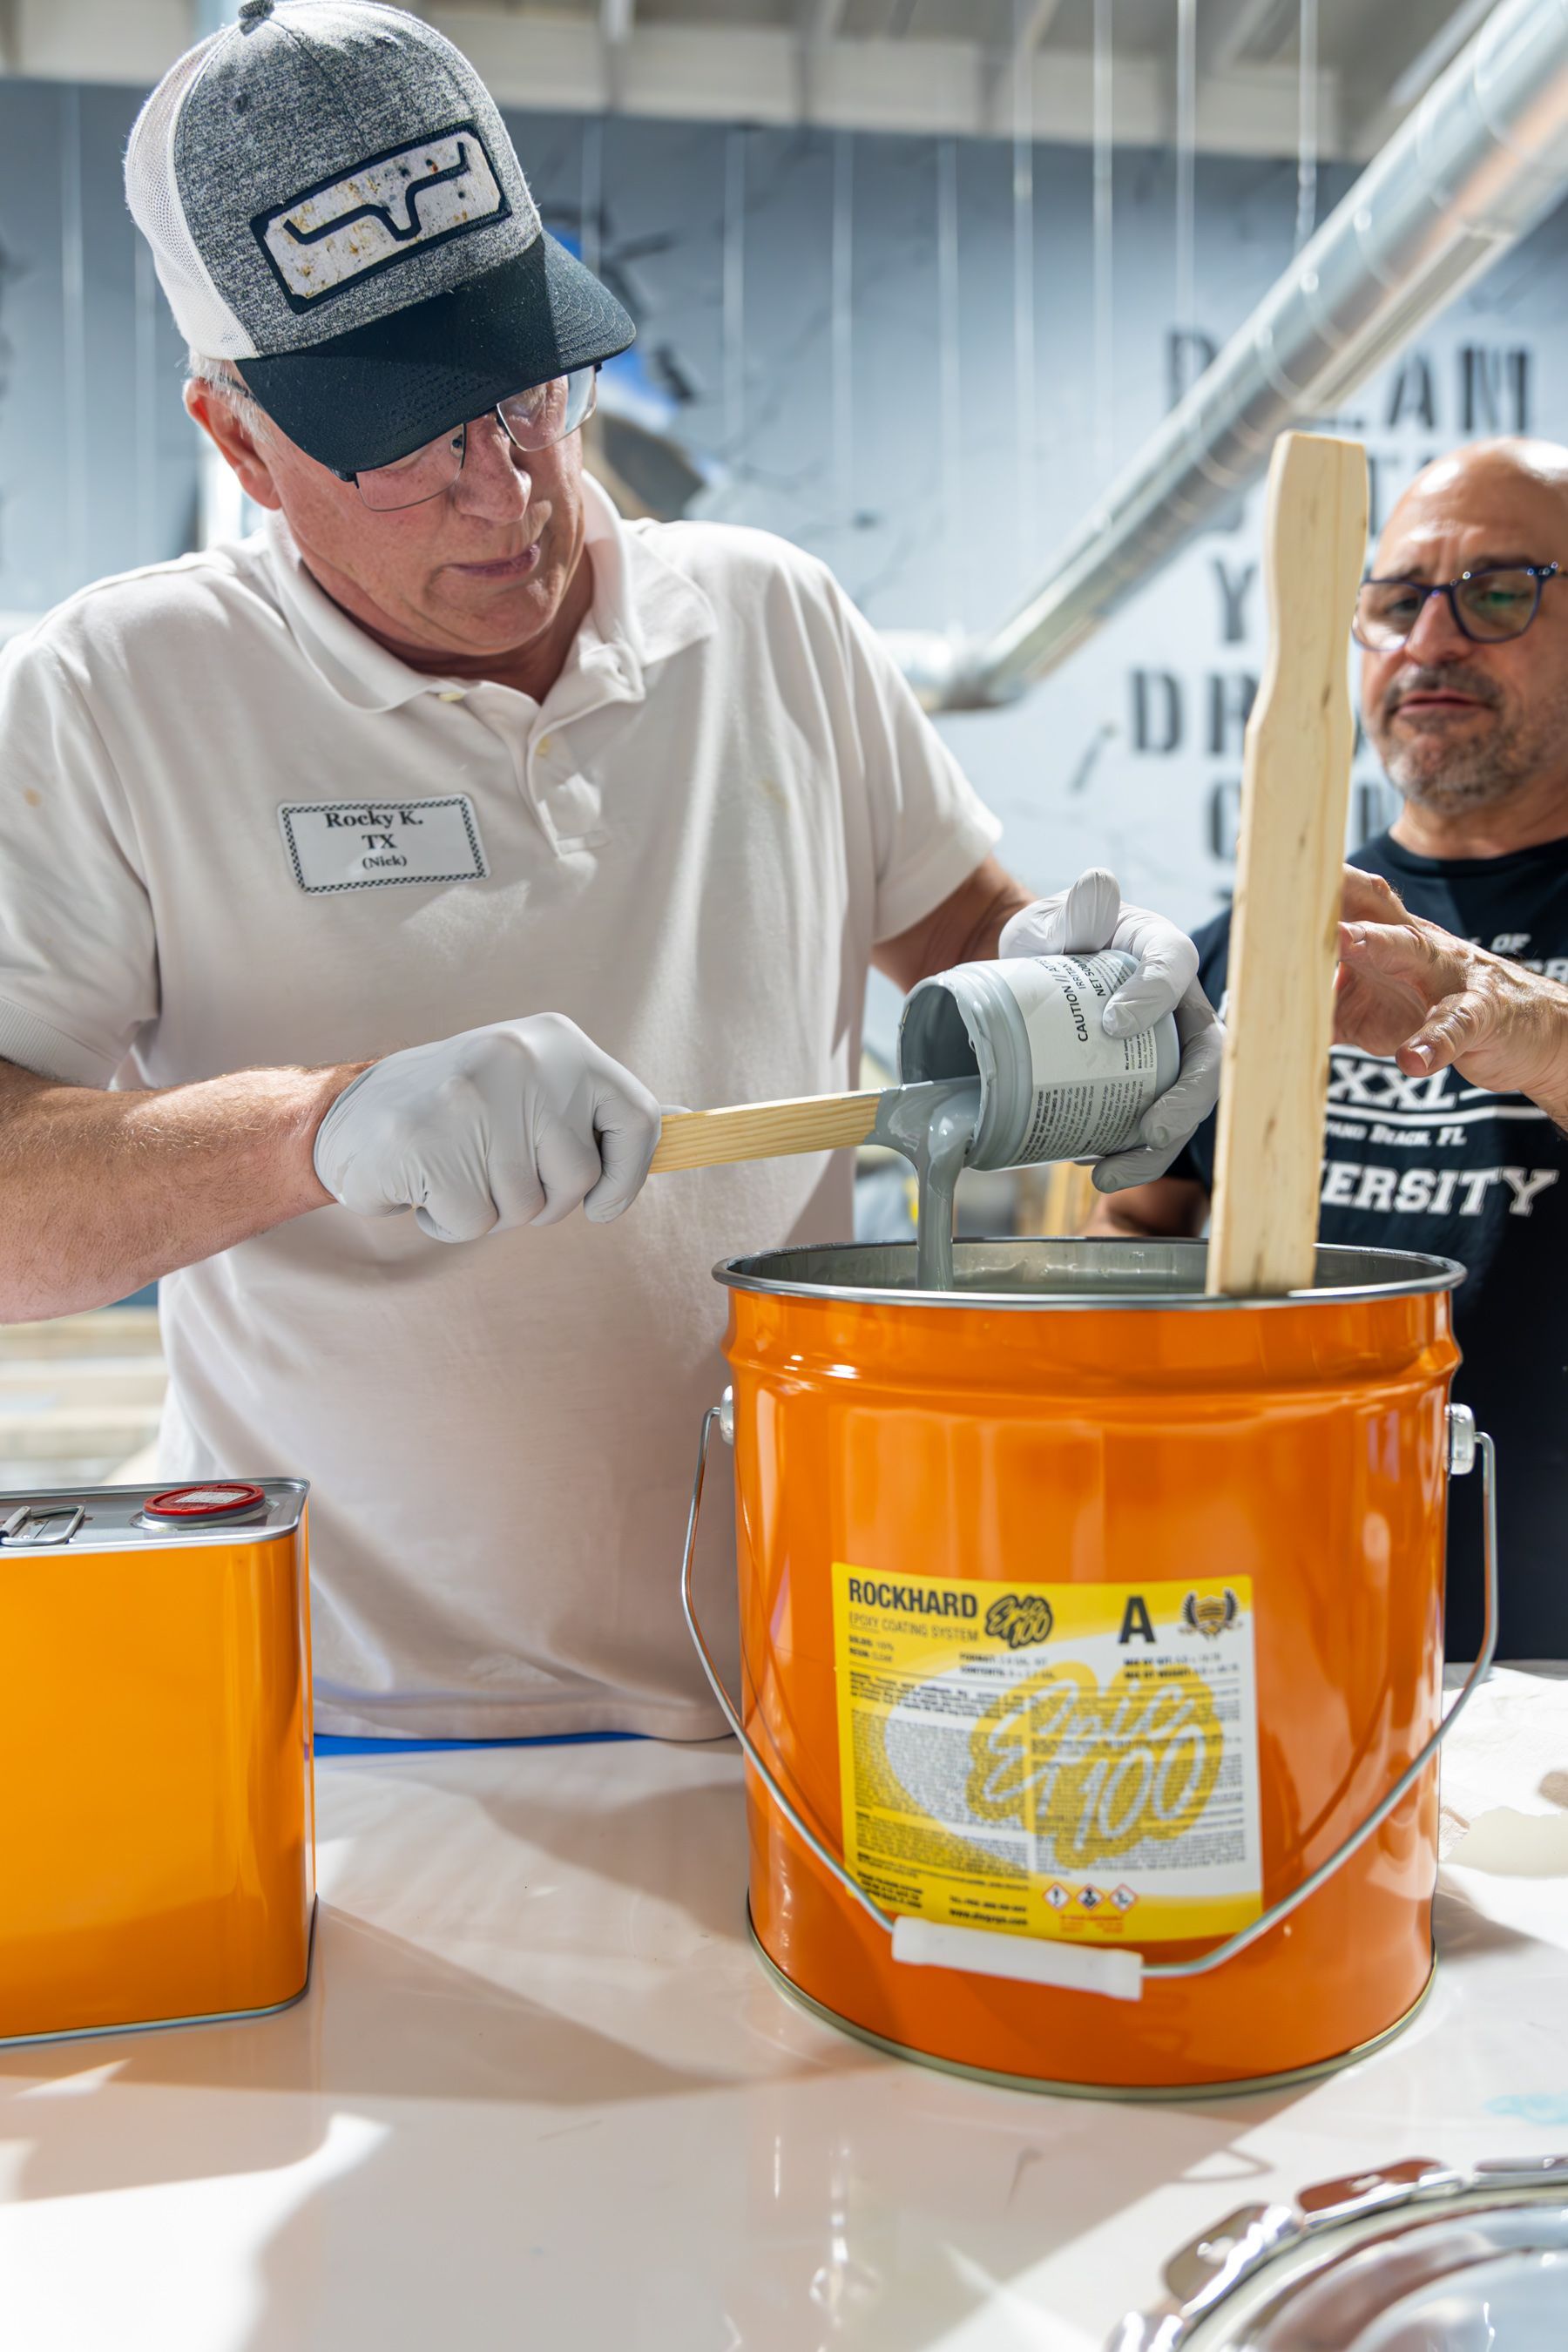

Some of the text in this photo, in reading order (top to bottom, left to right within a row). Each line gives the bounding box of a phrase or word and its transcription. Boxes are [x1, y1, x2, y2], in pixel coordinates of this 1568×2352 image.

[1167, 329, 1531, 433] DAM
[324, 810, 424, 829] Rocky K.
[362, 833, 398, 850] TX
[362, 855, 408, 870] (Nick)
[1056, 962, 1087, 989] IRRITAN
[1089, 978, 1106, 997] NET
[1061, 985, 1089, 1042] CAUTION
[1436, 1125, 1467, 1147] FL
[1320, 1159, 1560, 1217] ERSITY
[848, 1578, 978, 1619] ROCKHARD
[849, 1612, 979, 1643] EPOXY COATING SYSTEM
[1118, 1595, 1157, 1645] A
[1071, 1722, 1207, 1851] 100
